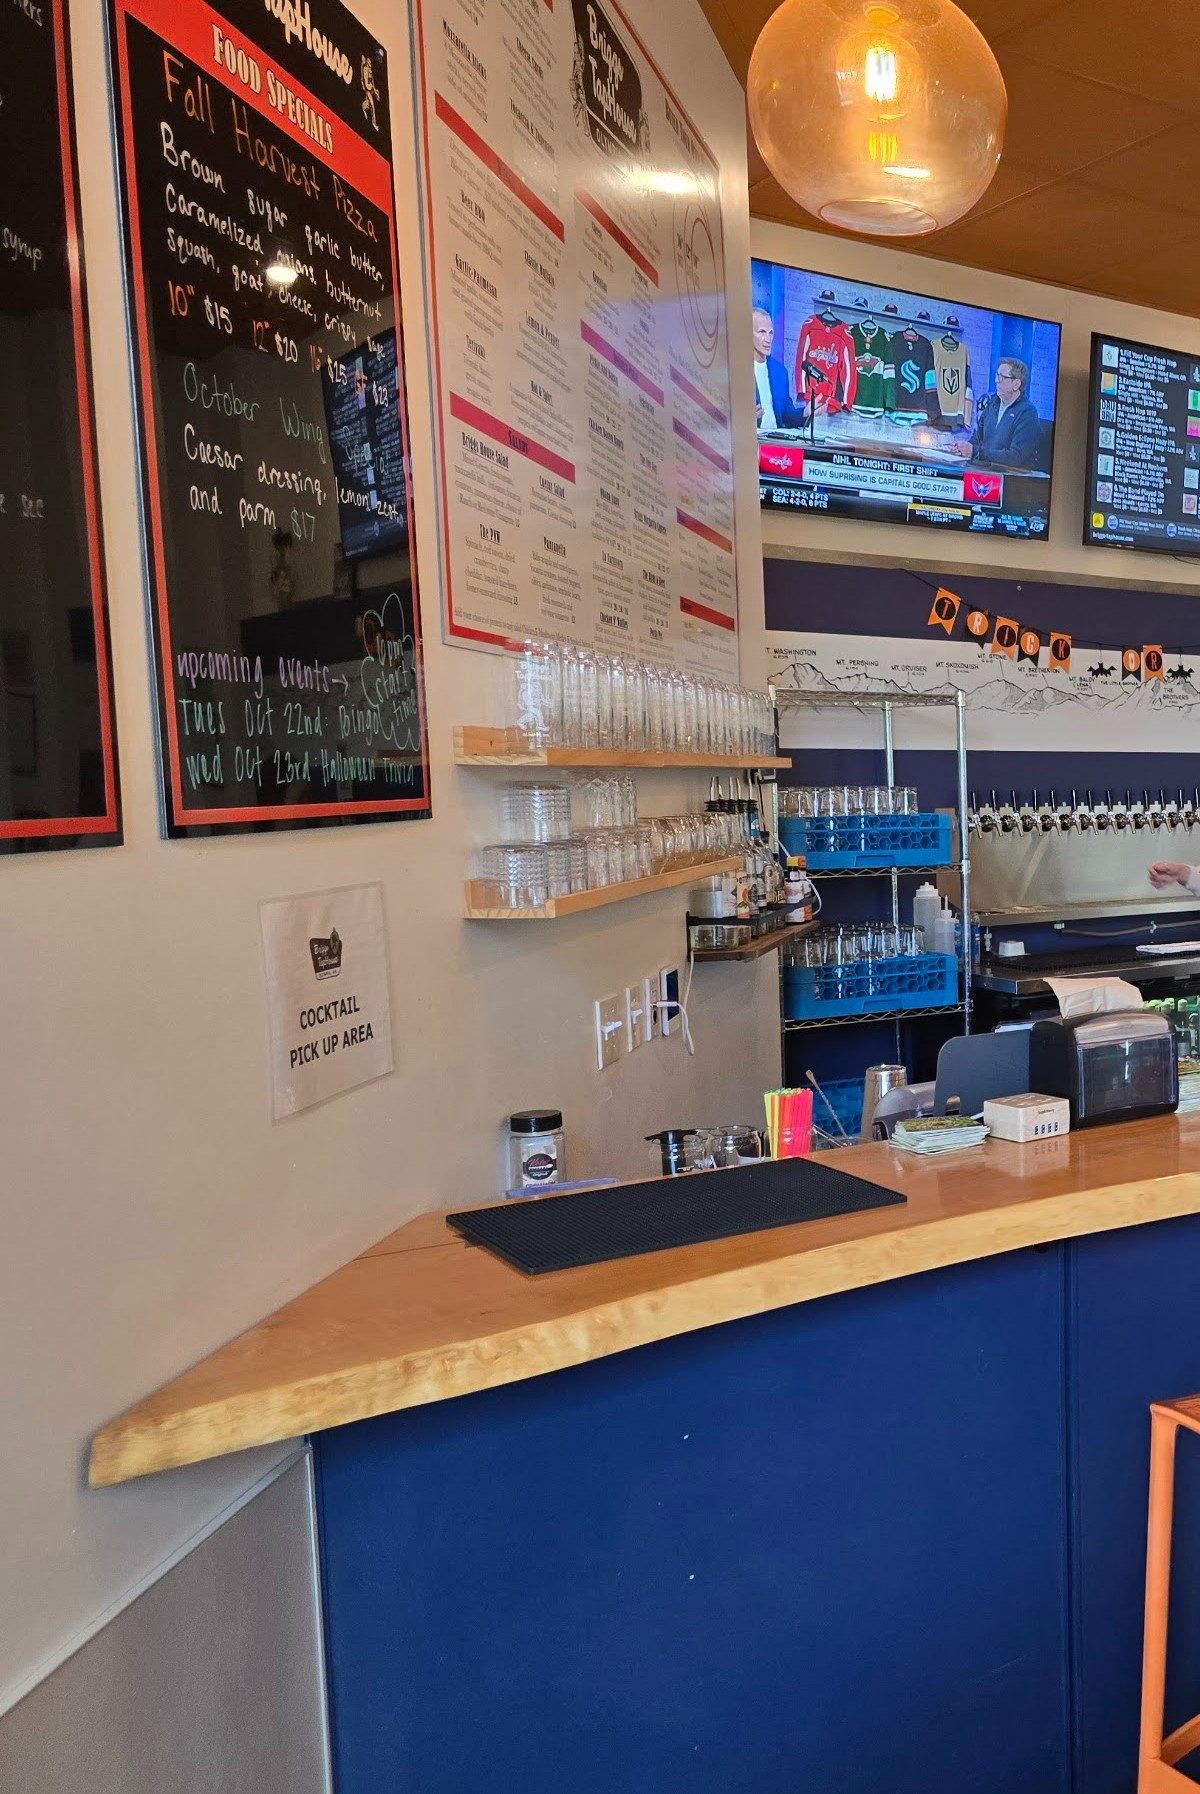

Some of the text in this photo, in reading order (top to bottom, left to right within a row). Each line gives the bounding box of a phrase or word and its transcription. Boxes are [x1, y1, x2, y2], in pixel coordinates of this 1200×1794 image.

[587, 4, 624, 90] Briggs
[211, 24, 334, 153] FOOD SPECIALS
[588, 55, 637, 144] TapHouse
[163, 50, 215, 134] Fall
[232, 99, 321, 201] Harvest
[333, 174, 378, 243] Pizza
[161, 122, 226, 194] Brown
[247, 189, 288, 236] sugar
[305, 224, 341, 260] garlic
[3, 227, 43, 271] syrup
[232, 265, 263, 294] goat
[325, 313, 356, 348] crispy
[325, 270, 382, 322] butternut
[205, 295, 233, 334] $15
[275, 333, 298, 364] $20
[327, 355, 348, 385] $25
[184, 362, 260, 422] October
[280, 396, 326, 464] Wing
[184, 423, 243, 471] Caesar
[335, 476, 370, 512] lemon
[808, 467, 827, 477] HOW
[829, 470, 868, 483] SUPRISING
[869, 474, 877, 483] IS
[878, 475, 911, 489] CAPITALS
[912, 479, 931, 490] GOOD
[833, 454, 938, 477] NHL TONIGHT: FIRST SHIFT
[190, 485, 316, 543] and parm $17
[479, 523, 488, 539] The
[774, 648, 817, 656] WASHINGTON
[941, 599, 1067, 659] TRICK
[177, 649, 264, 699] upcoming
[178, 698, 226, 737] Tues
[244, 702, 274, 738] Oct
[235, 746, 263, 786] Oct
[322, 748, 376, 787] Halloween
[299, 995, 360, 1031] COCKTAIL
[289, 1022, 374, 1069] PICK UP AREA
